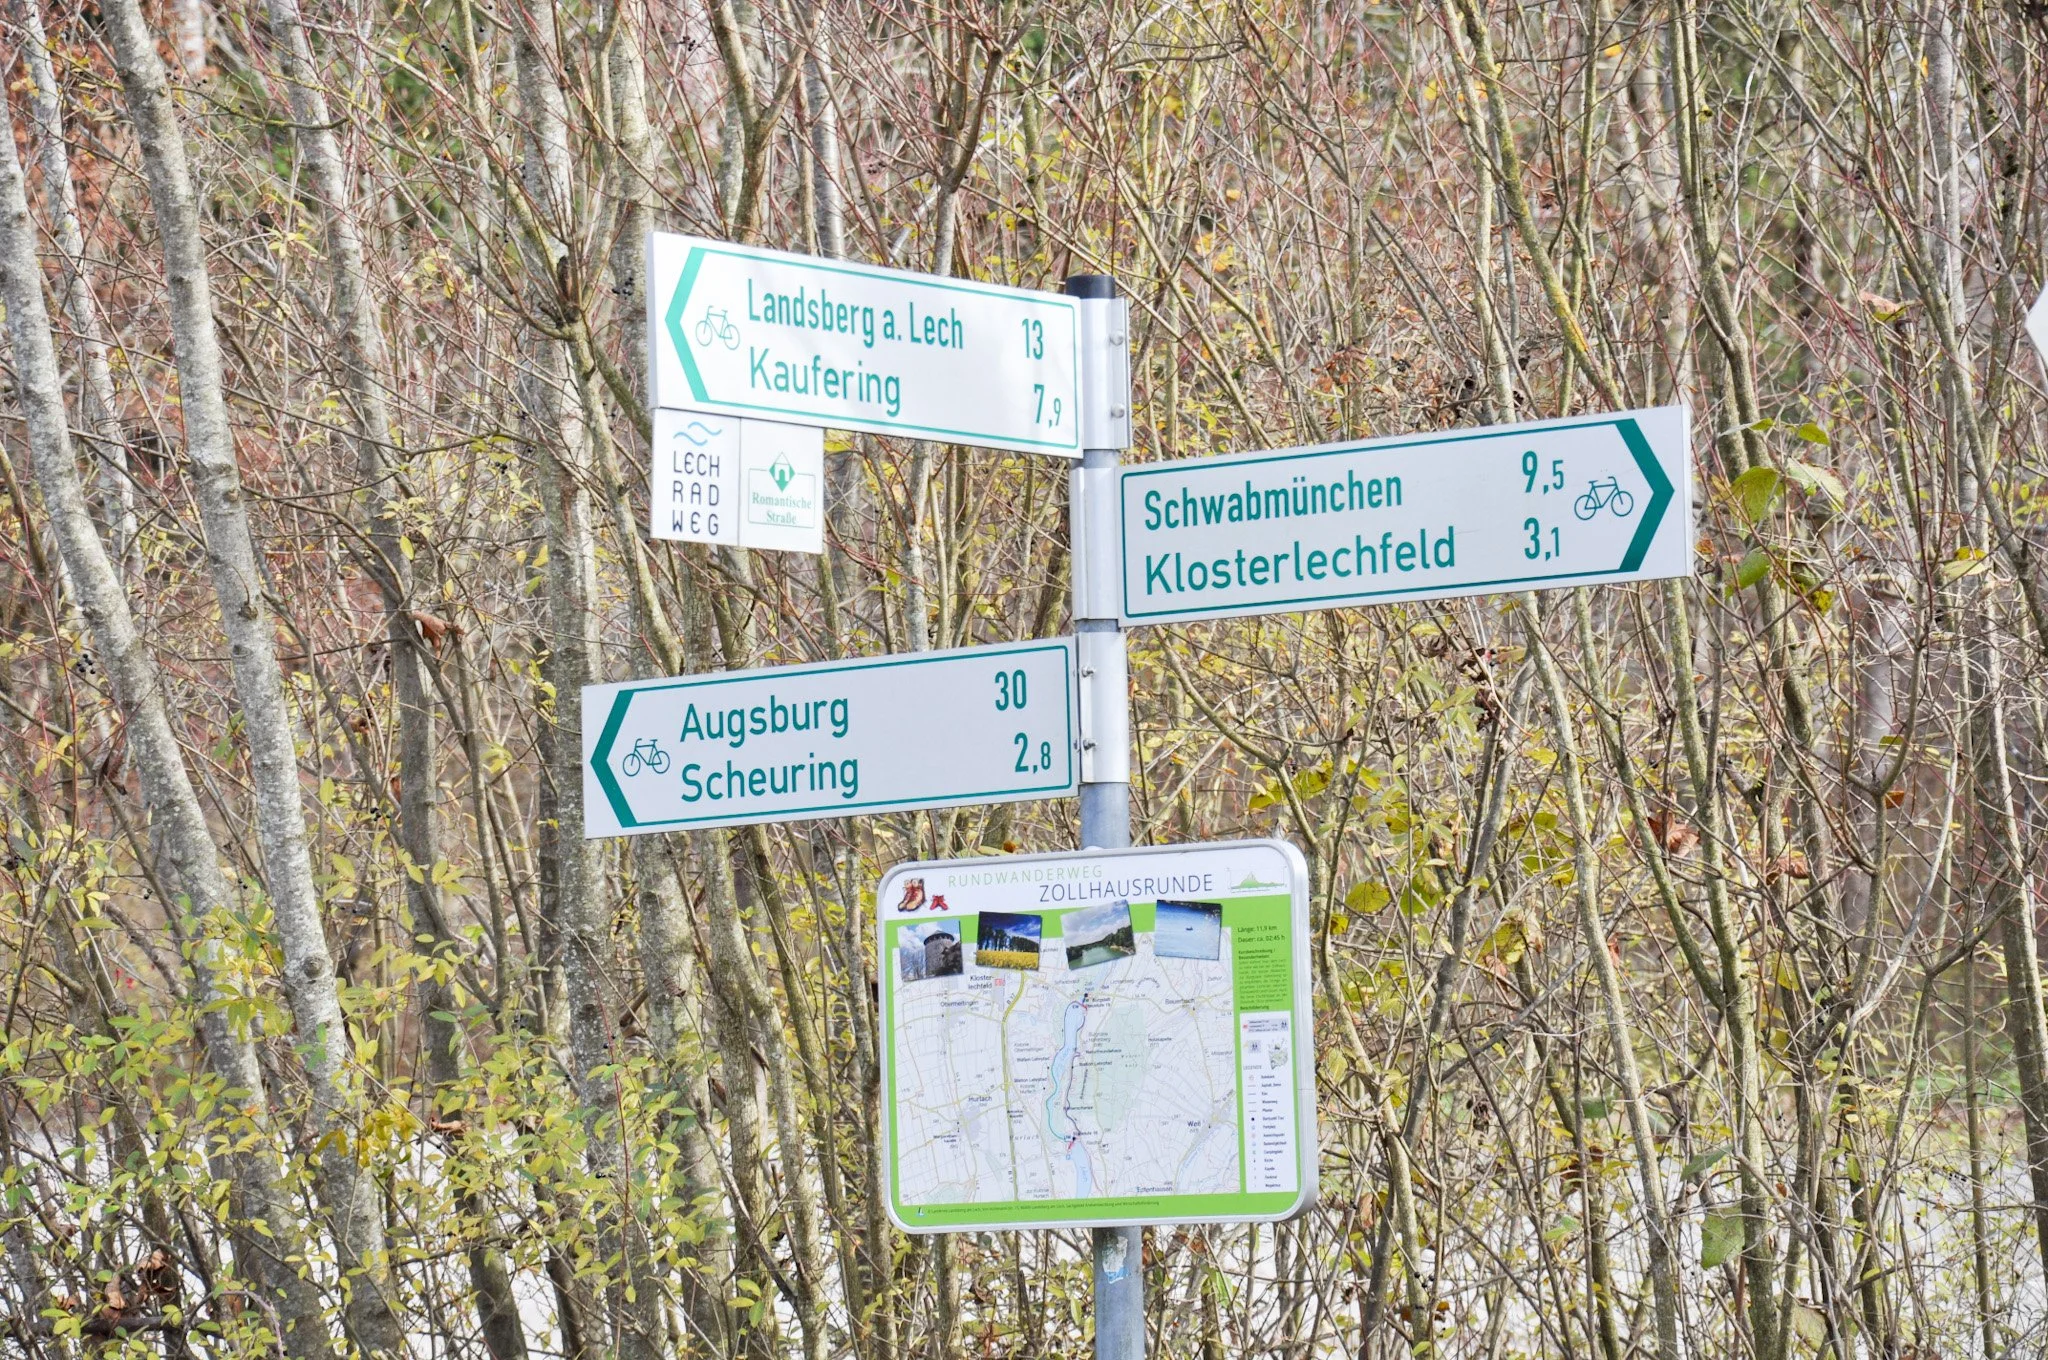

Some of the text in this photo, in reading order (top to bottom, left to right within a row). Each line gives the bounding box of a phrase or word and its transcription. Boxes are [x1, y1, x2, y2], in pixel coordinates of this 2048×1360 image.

[748, 278, 964, 350] Landsberg a. Lech
[1021, 318, 1044, 361] 13
[750, 346, 901, 418] Kaufering
[1033, 383, 1062, 428] 7,9
[673, 450, 720, 478] LECH
[1521, 450, 1565, 495] 9,5
[672, 480, 720, 507] RAD
[751, 491, 812, 510] Romantische
[1144, 469, 1402, 531] Schwabmünchen
[672, 509, 719, 537] WEG
[766, 510, 797, 525] Straße
[1145, 526, 1456, 595] Klosterlechfeld
[1523, 517, 1560, 562] 3,1
[994, 669, 1027, 712] 30
[679, 694, 849, 749] Augsburg
[1013, 731, 1052, 774] 2,8
[681, 752, 859, 803] Scheuring
[948, 865, 1103, 888] RUNDWANDERWEG
[1039, 874, 1213, 903] ZOLLHAUSRUNDE
